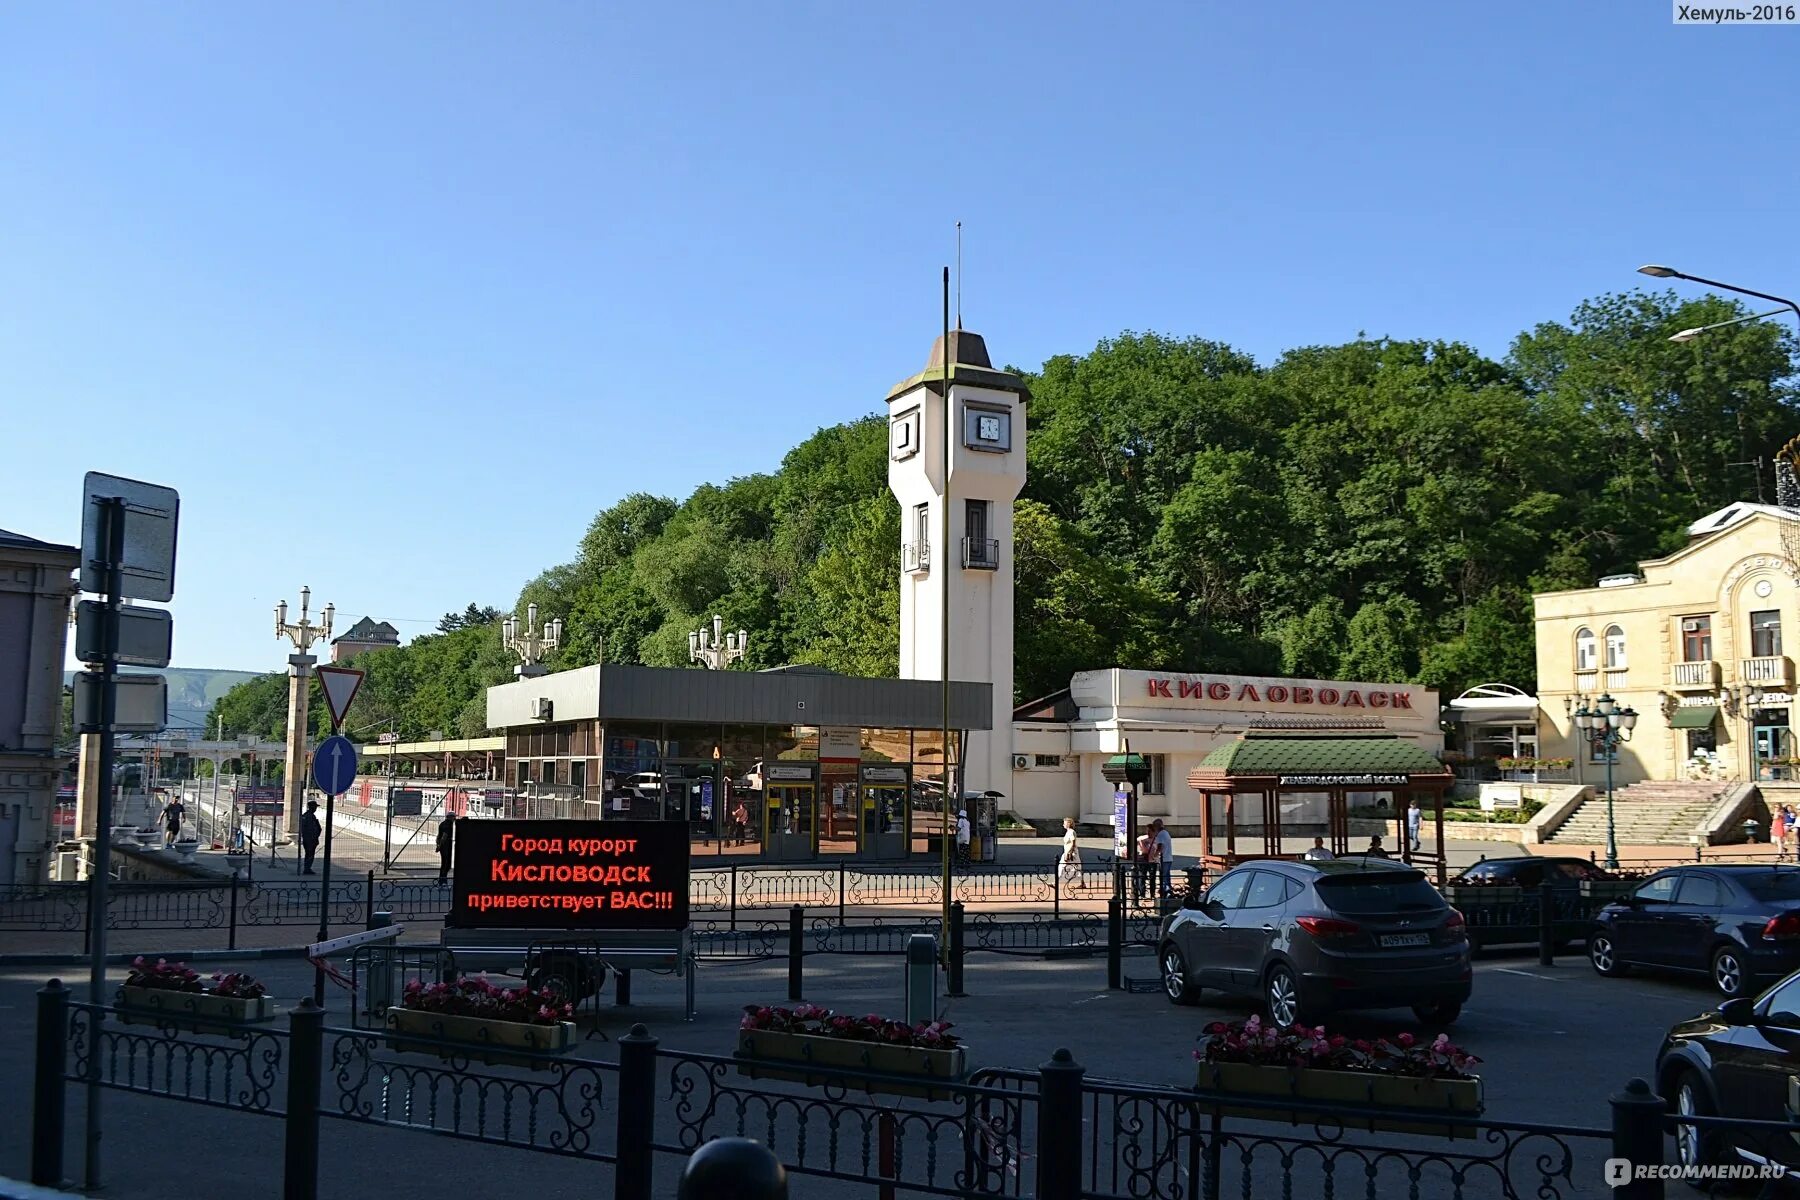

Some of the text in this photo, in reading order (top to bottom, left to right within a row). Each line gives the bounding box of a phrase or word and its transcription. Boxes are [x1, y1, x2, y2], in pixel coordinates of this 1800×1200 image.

[1147, 678, 1412, 709] КИСЛОВОДСК
[1280, 774, 1408, 785] ЖЕЛЕЗНОДОРОЖНЫЙ ВОКЗАЛ
[501, 834, 638, 856] Город курорт
[491, 859, 651, 885] Кисловодск
[468, 891, 673, 912] приветствует ВАС!!!
